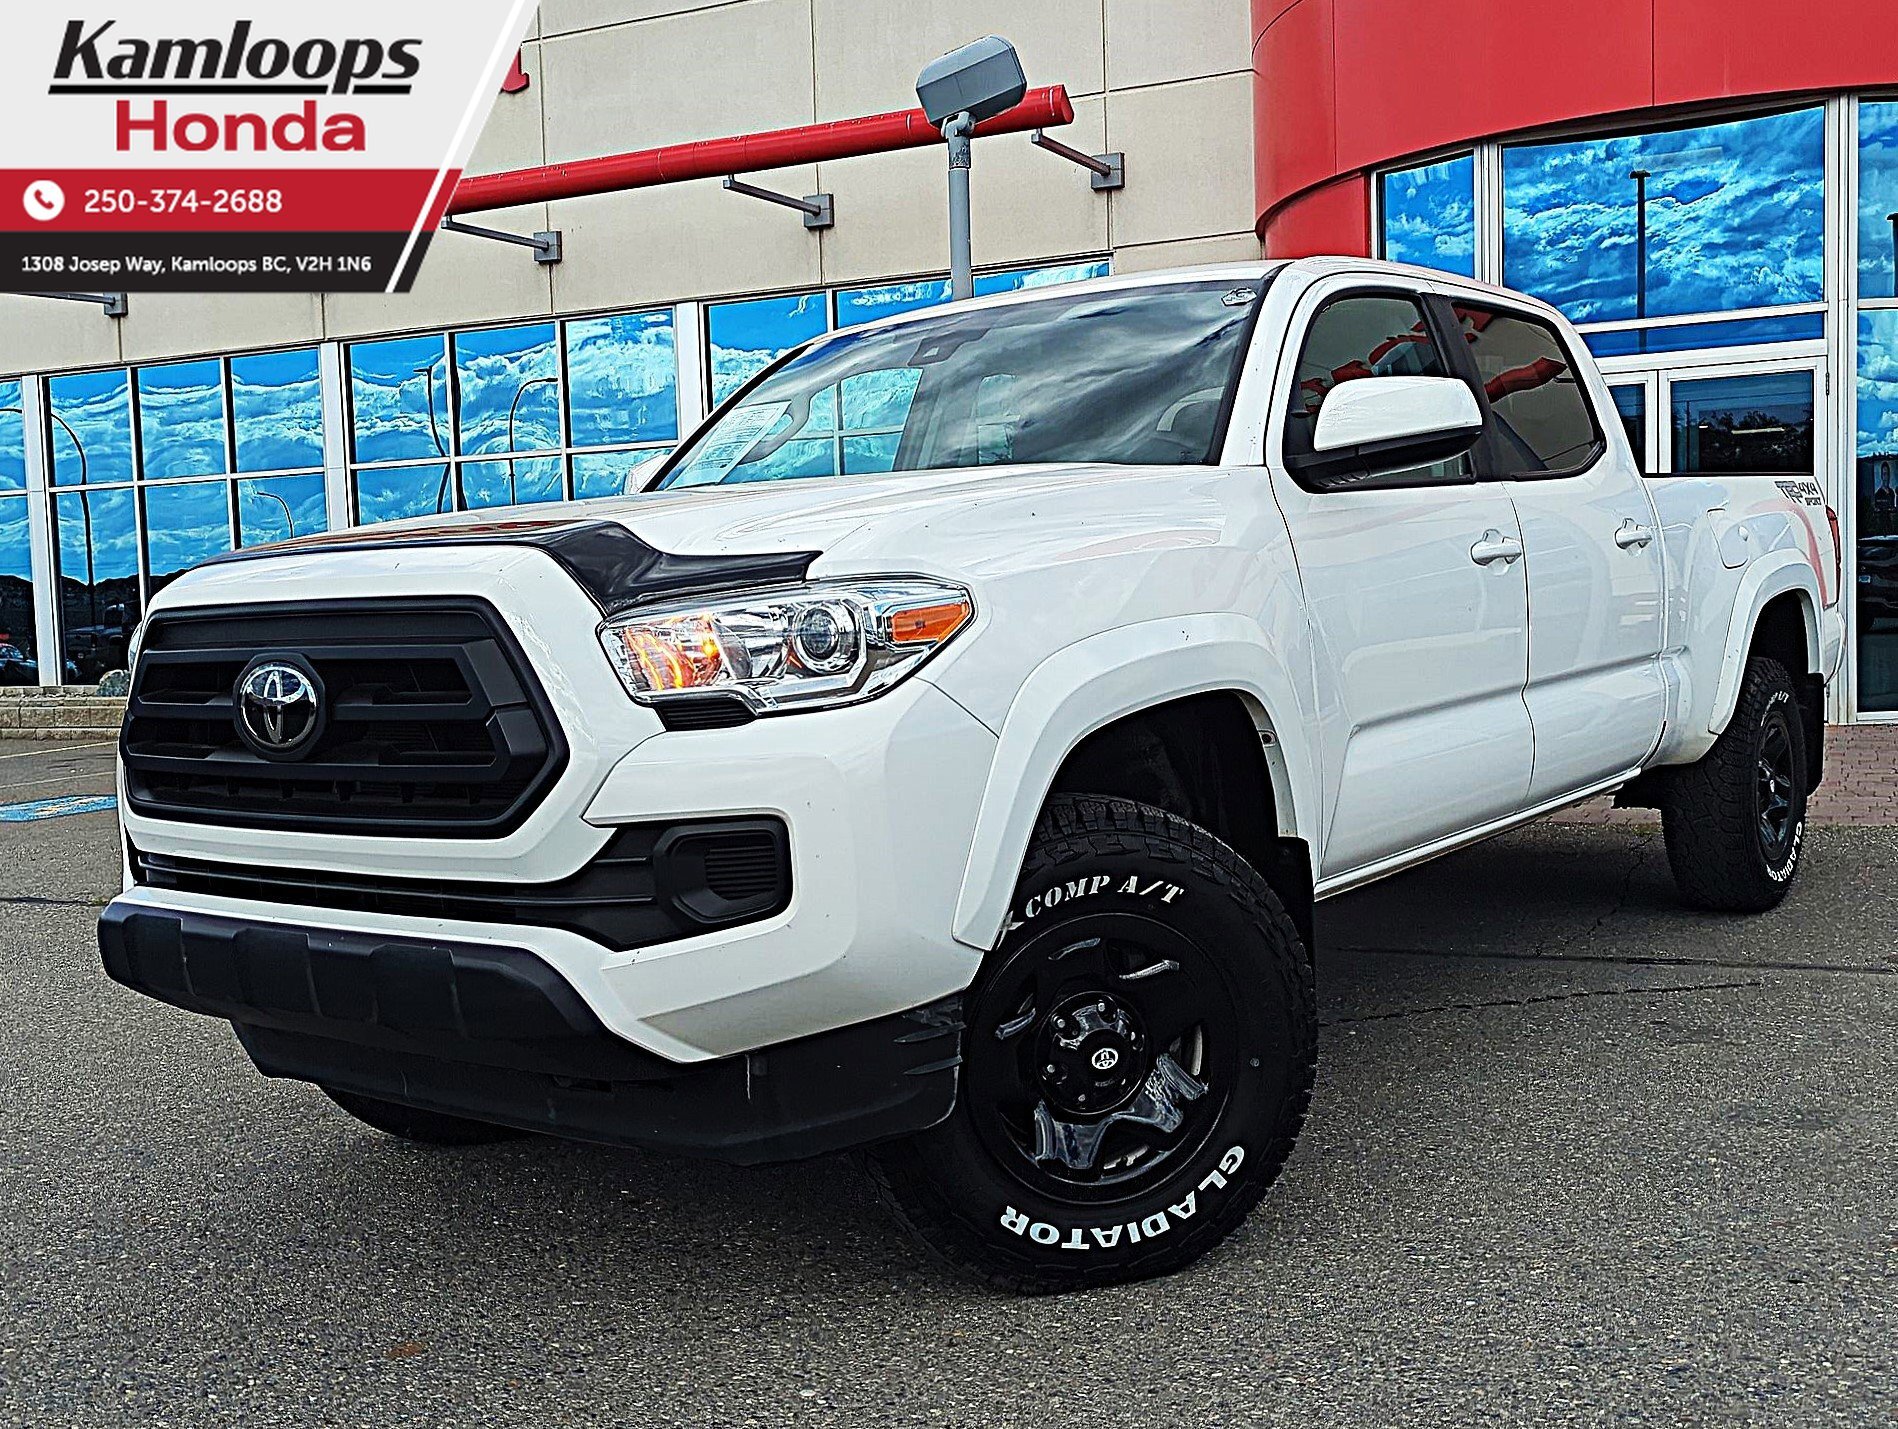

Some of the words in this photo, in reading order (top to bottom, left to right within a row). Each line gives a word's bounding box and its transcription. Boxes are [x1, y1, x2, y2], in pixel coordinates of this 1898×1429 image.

[1025, 875, 1110, 919] COMP
[1117, 875, 1186, 904] A/T
[1000, 1145, 1245, 1250] GLADIATOR
